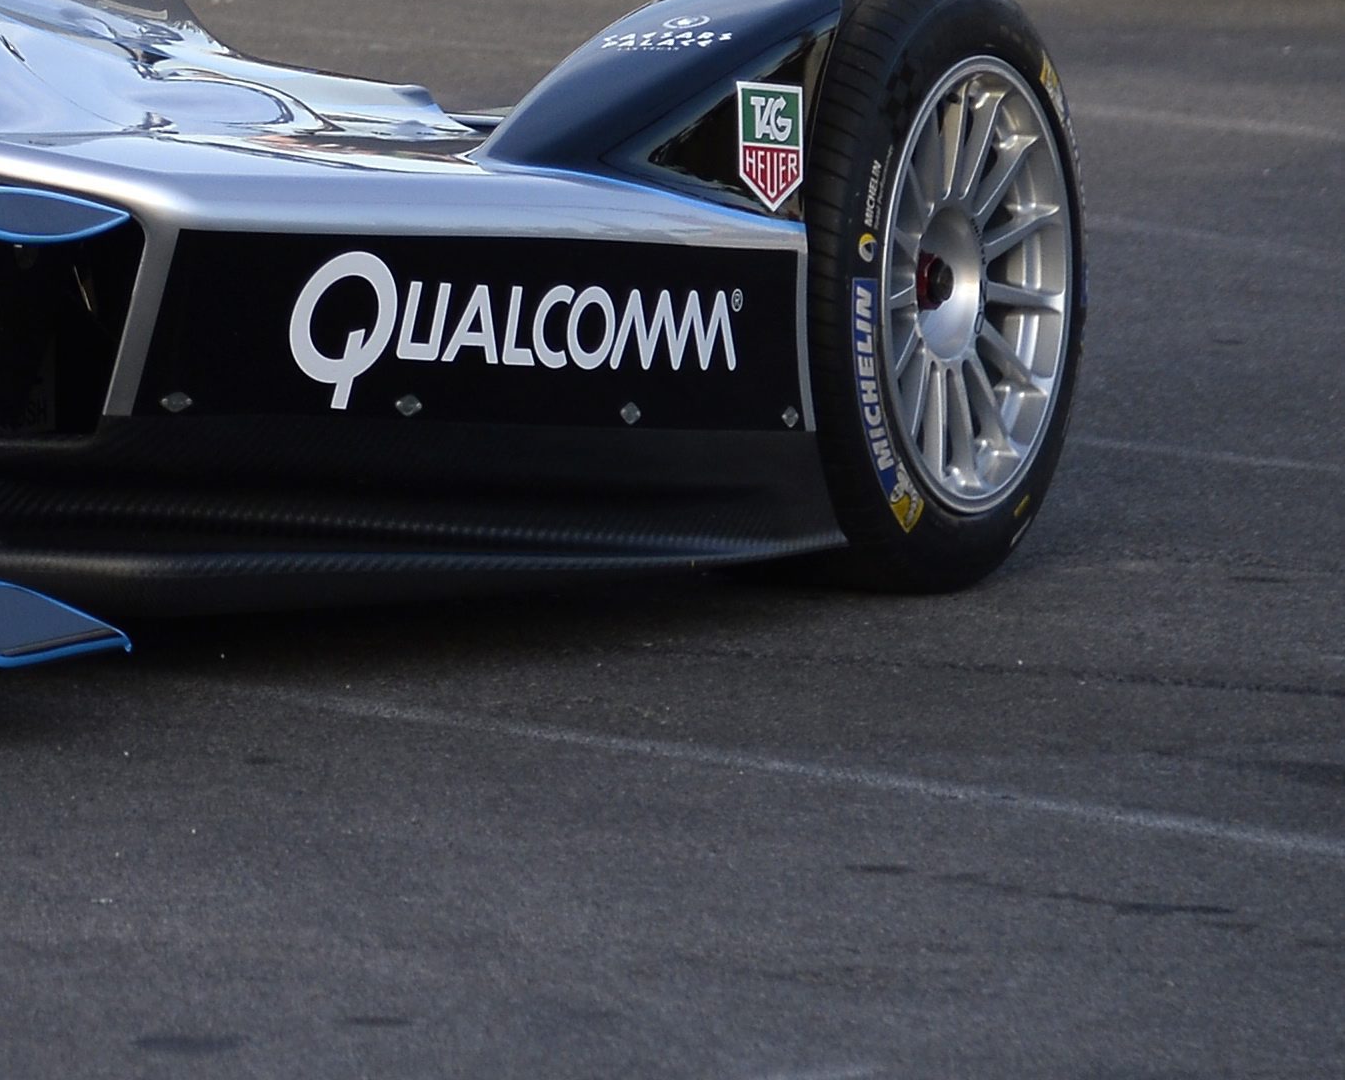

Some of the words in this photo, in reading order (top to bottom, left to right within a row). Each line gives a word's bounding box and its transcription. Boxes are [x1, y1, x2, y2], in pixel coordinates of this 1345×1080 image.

[750, 96, 793, 142] TAG
[745, 149, 798, 199] HEUER
[855, 286, 895, 470] MICHELIN
